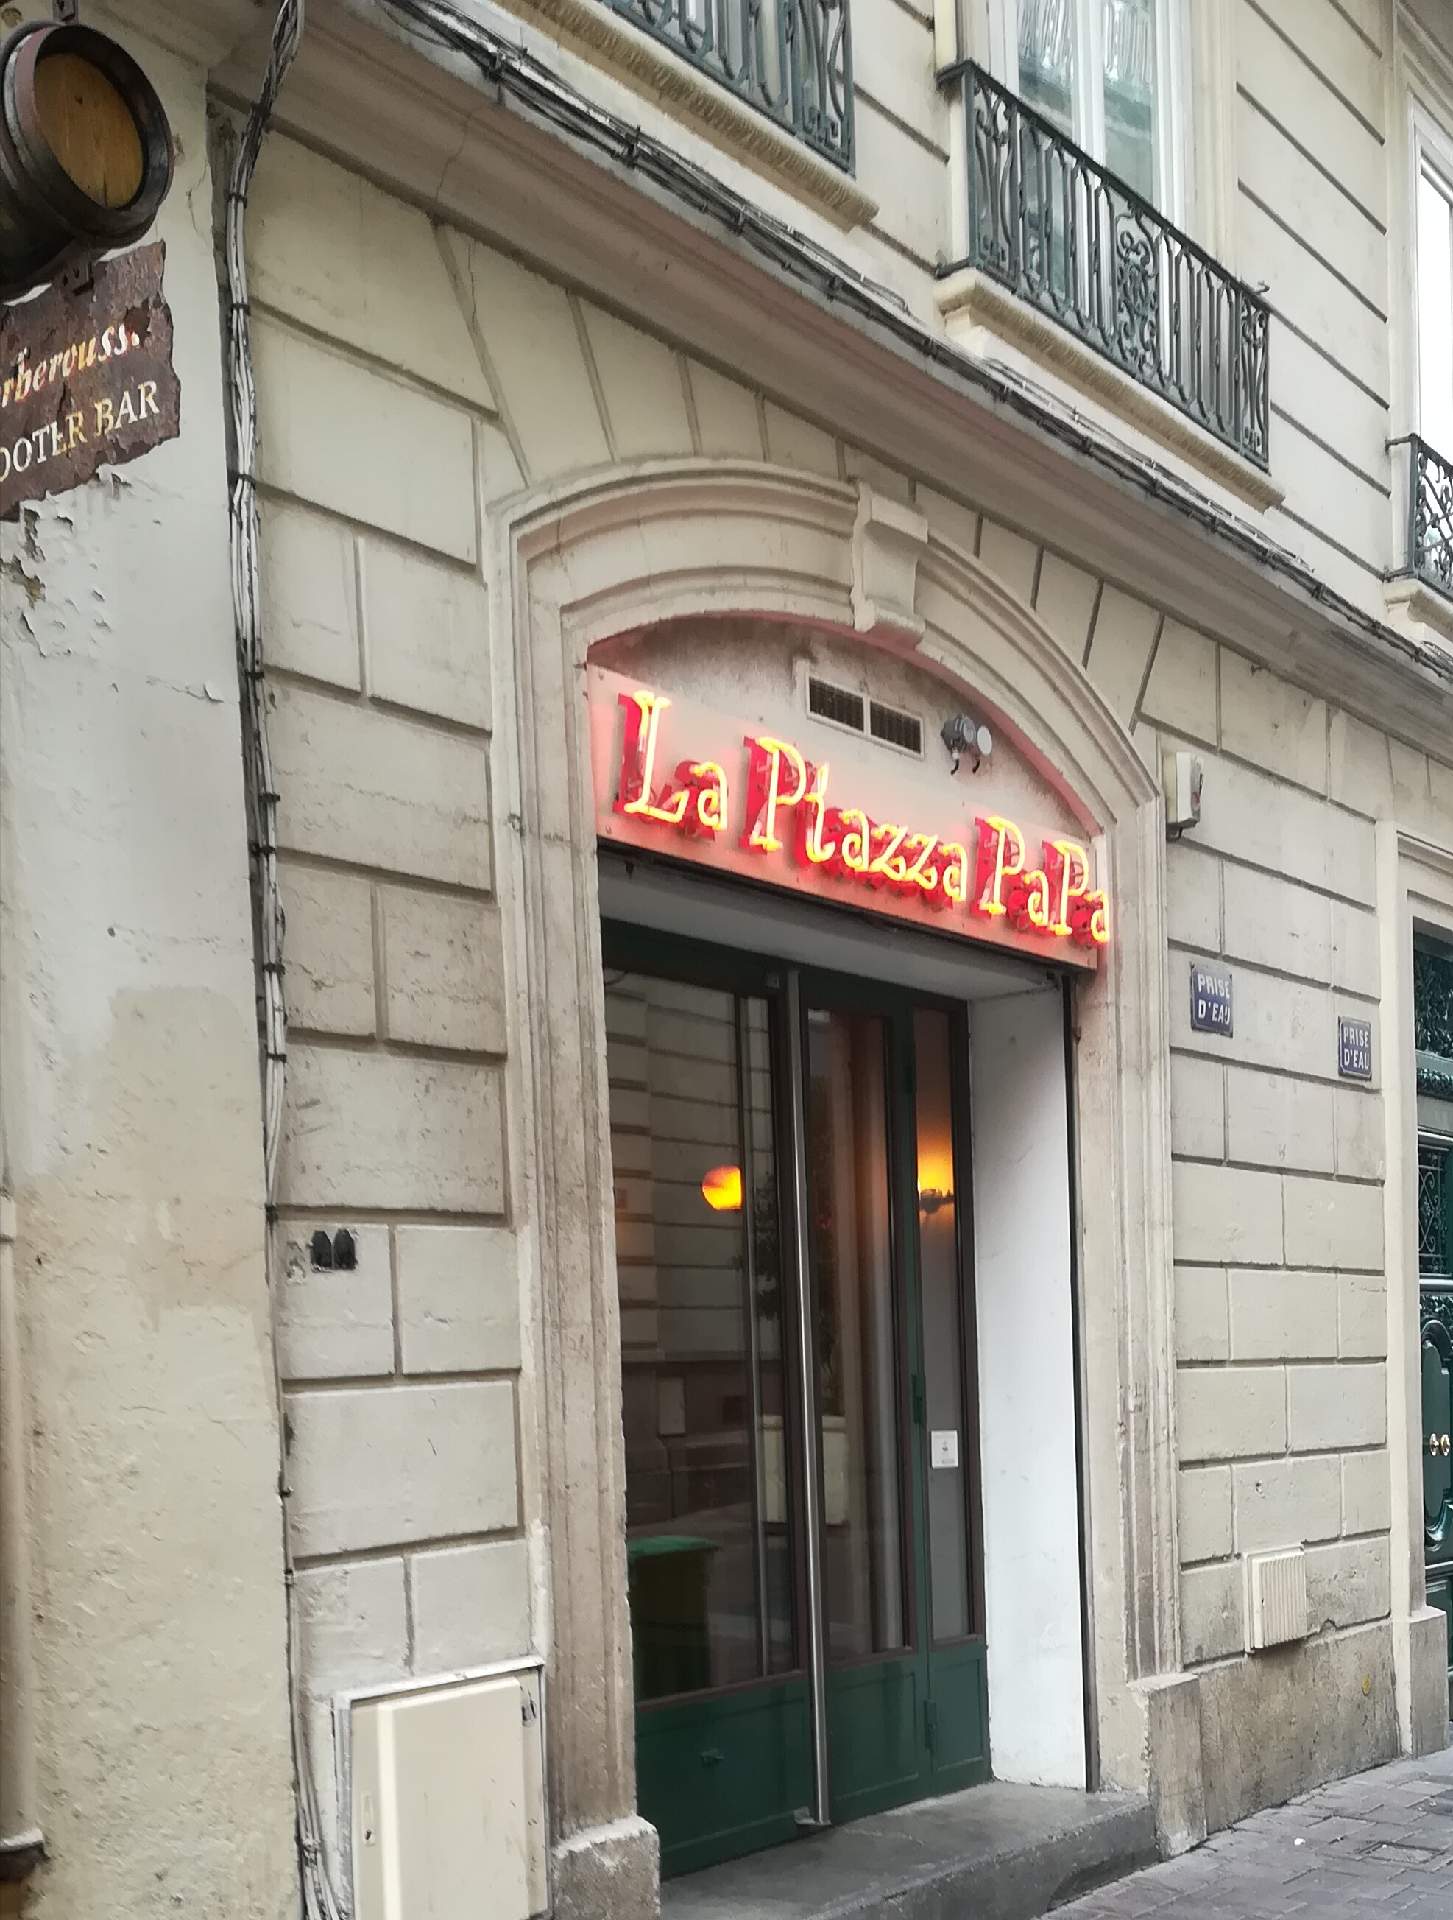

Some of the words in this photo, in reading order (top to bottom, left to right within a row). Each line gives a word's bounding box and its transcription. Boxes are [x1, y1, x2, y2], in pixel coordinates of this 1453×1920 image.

[0, 322, 140, 408] rberouss
[94, 381, 161, 438] BAR
[613, 690, 729, 840] La
[1197, 973, 1231, 1000] PRISE
[1198, 999, 1231, 1025] D'EAU
[1343, 1026, 1369, 1048] PRISE
